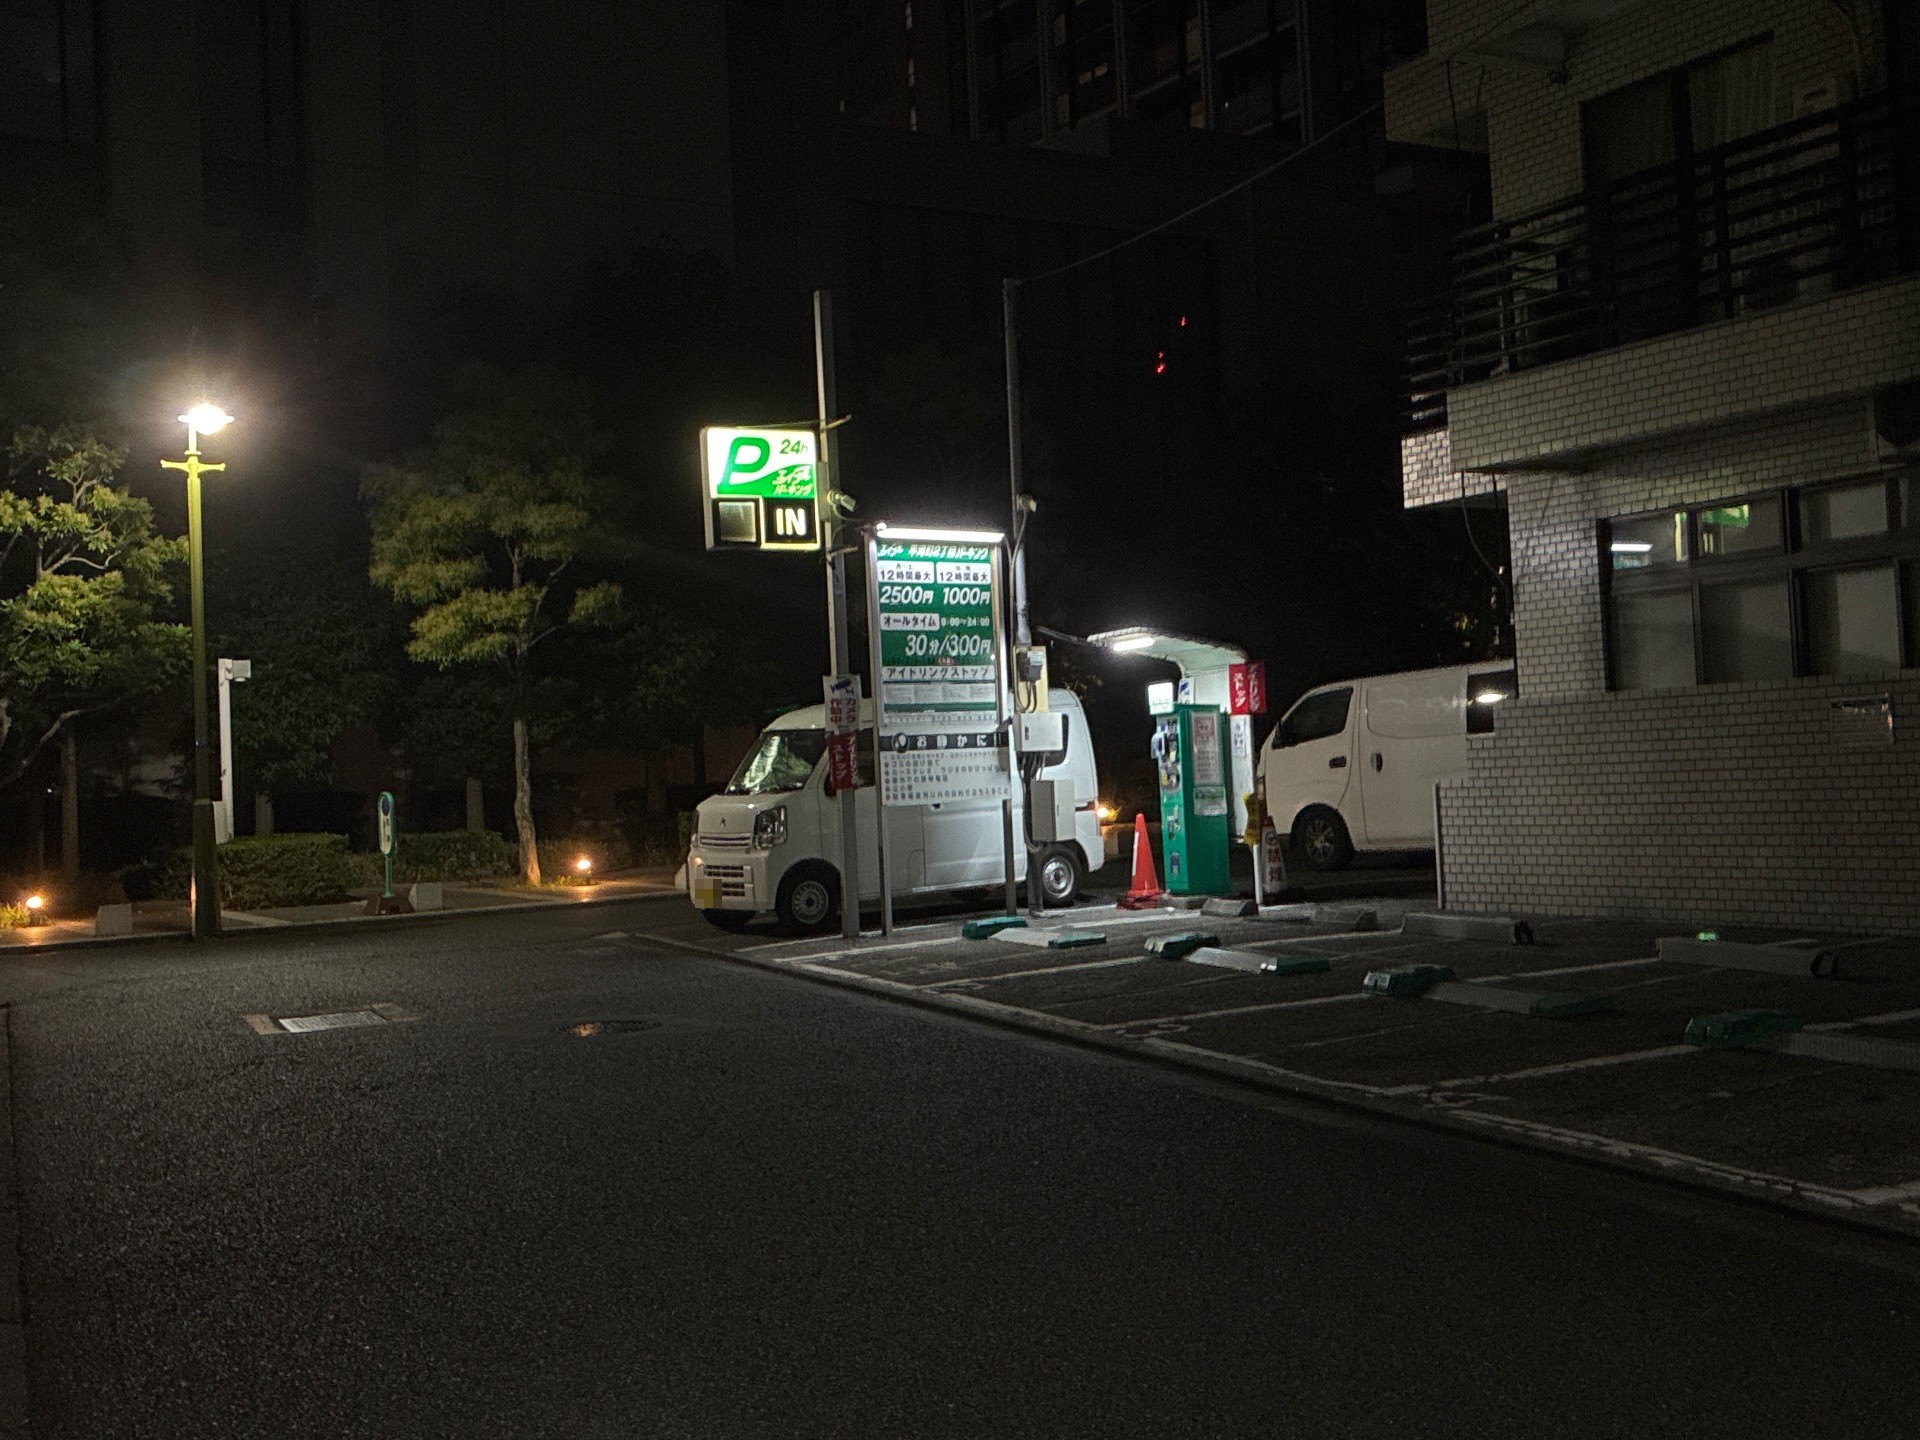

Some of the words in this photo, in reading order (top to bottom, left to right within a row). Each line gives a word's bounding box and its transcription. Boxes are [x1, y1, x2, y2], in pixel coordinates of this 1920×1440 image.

[780, 439, 808, 454] 24h
[776, 508, 806, 535] IN
[880, 570, 931, 580] 12時間最大
[940, 572, 988, 582] 12時間最大
[880, 586, 934, 605] 2500円
[942, 587, 990, 605] 1000円
[884, 615, 936, 628] オールタイム
[887, 667, 989, 678] アイドリングストップ
